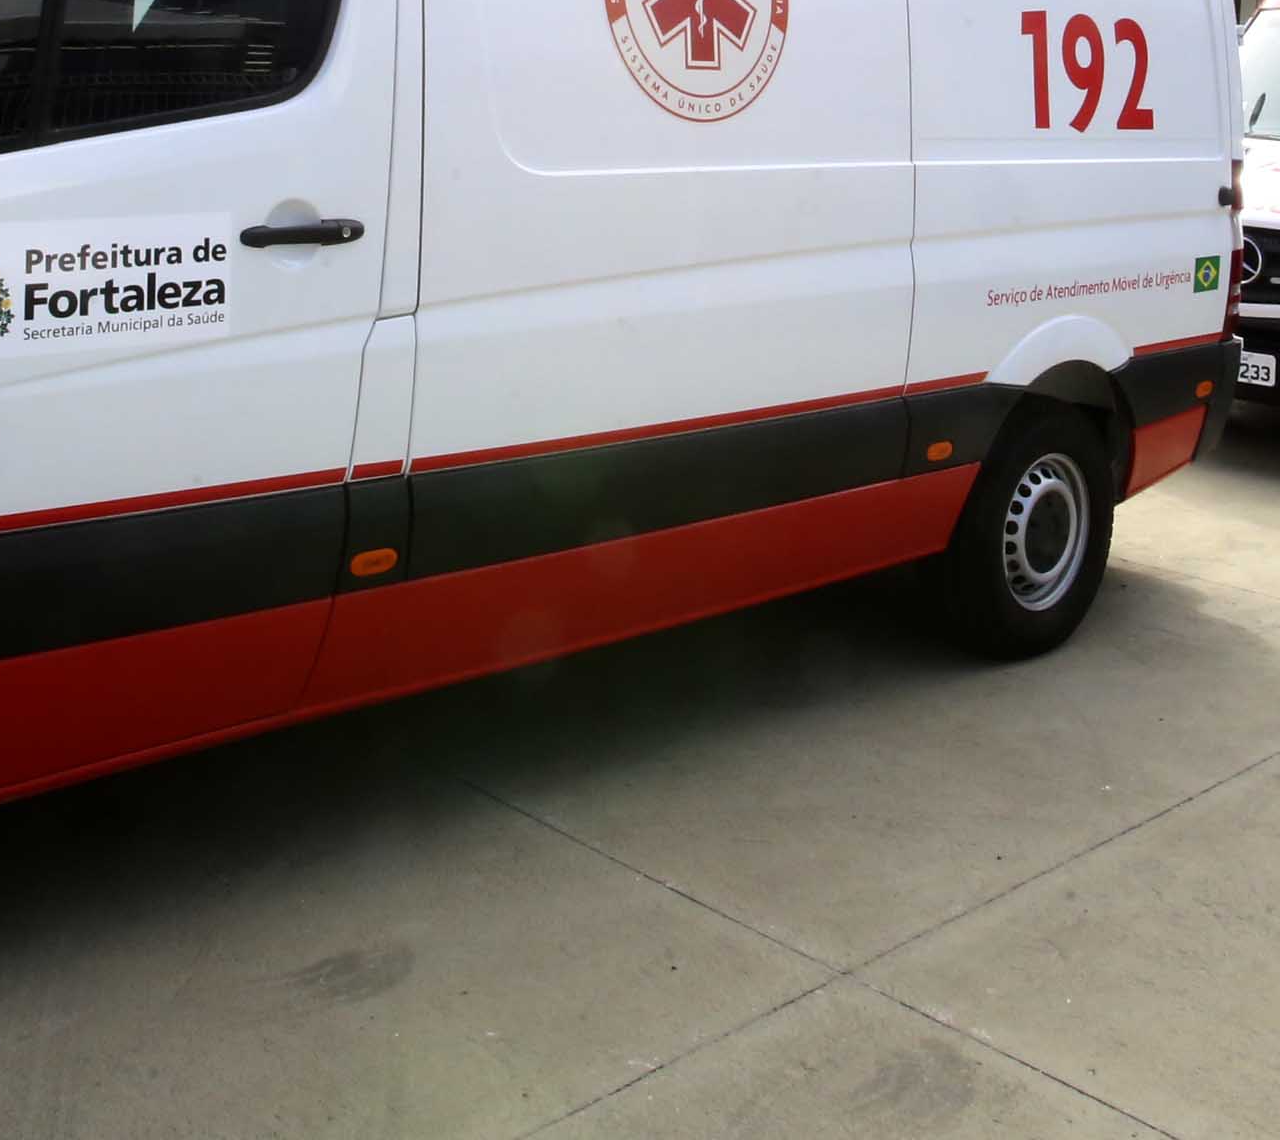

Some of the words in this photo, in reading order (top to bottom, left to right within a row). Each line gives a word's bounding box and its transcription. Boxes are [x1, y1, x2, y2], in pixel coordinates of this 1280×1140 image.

[621, 36, 668, 100] SISTEMA
[729, 93, 744, 107] DE
[1021, 10, 1154, 133] 192
[25, 244, 182, 275] Prefeitura
[193, 237, 227, 263] de
[24, 272, 226, 321] Fortaleza
[987, 289, 1027, 307] Serviço
[1030, 286, 1042, 301] de
[1045, 280, 1109, 300] Atendimento
[1112, 275, 1141, 293] Móvel
[1142, 274, 1153, 289] de
[1155, 271, 1192, 290] Urgência
[23, 322, 93, 341] Secretaria
[97, 315, 163, 334] Municipal
[167, 314, 183, 328] da
[187, 310, 225, 326] Saúde
